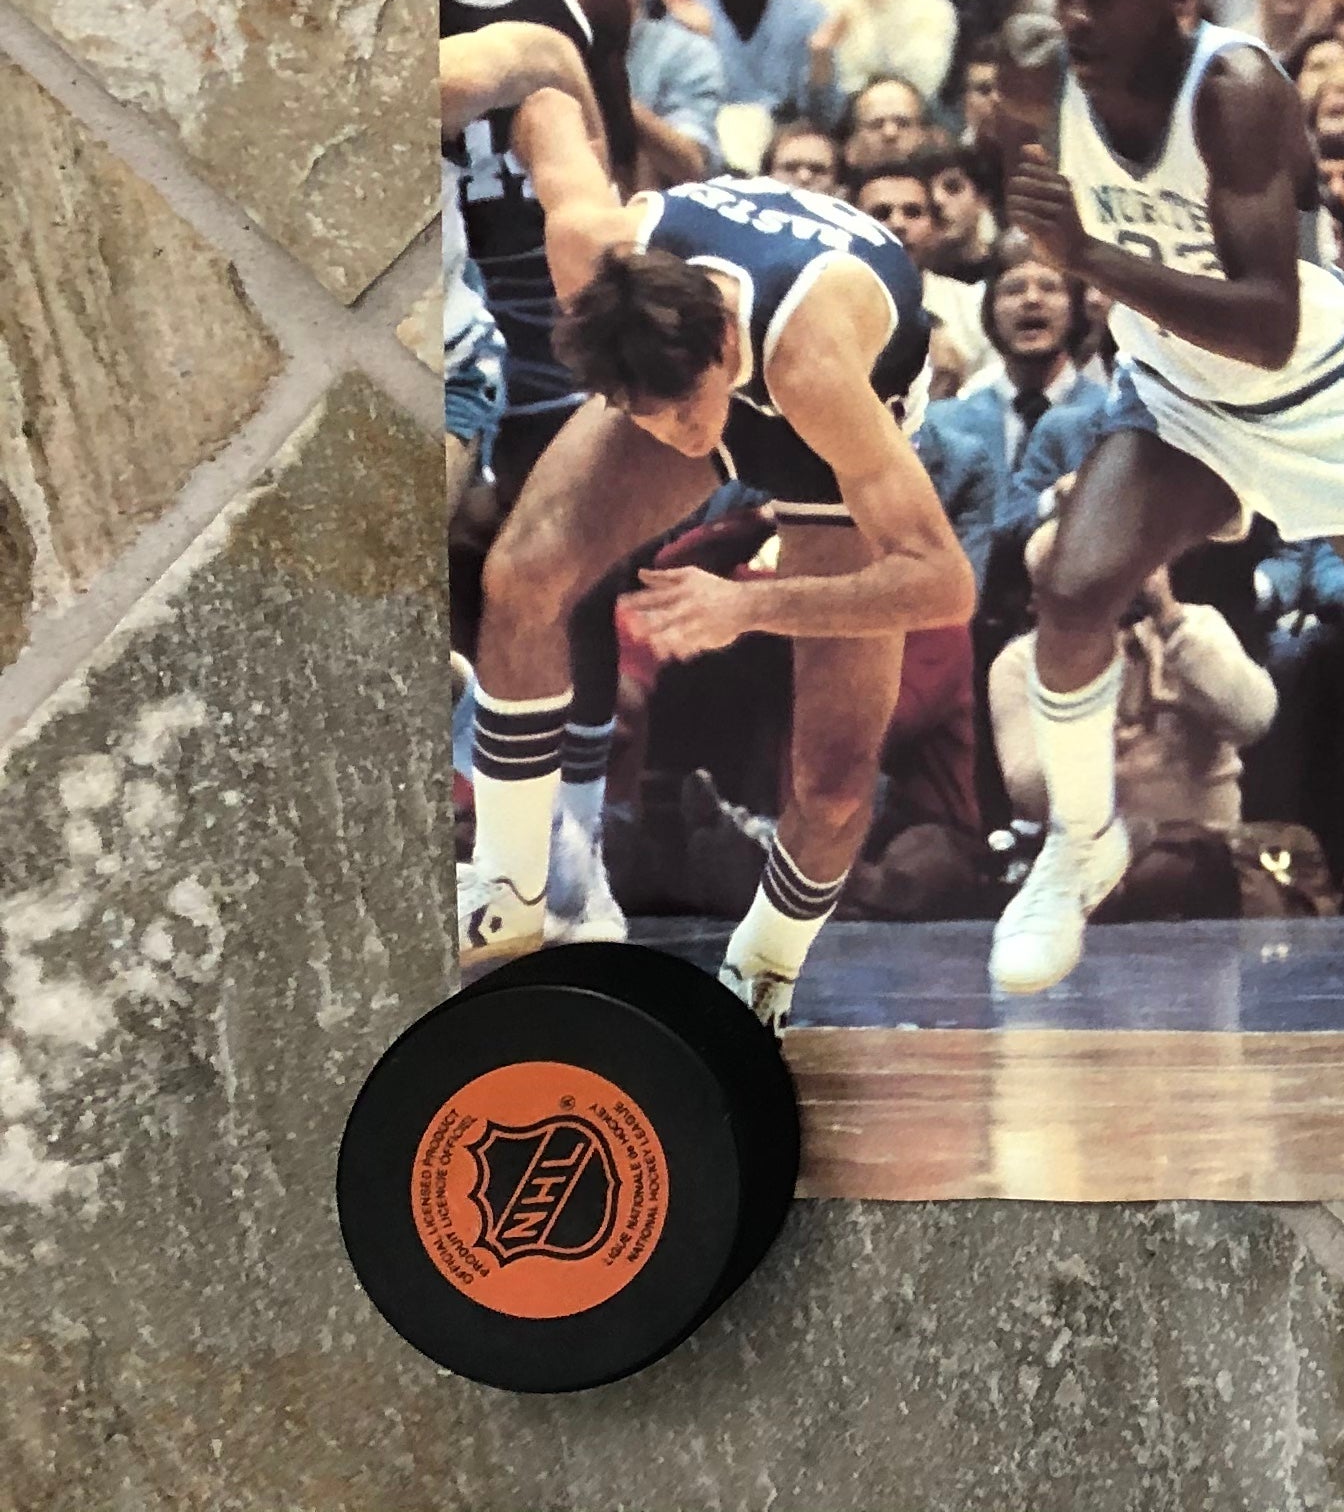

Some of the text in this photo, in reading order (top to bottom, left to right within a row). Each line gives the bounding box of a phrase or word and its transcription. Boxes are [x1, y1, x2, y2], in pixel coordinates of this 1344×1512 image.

[589, 1103, 627, 1145] HOCKEY
[420, 1108, 474, 1285] OFFICIAL LICENSED PRODUCT
[502, 1142, 585, 1238] NHL
[613, 1100, 660, 1262] NATIONAL HOCKEY LEAGUE
[445, 1231, 490, 1278] PRODUIT
